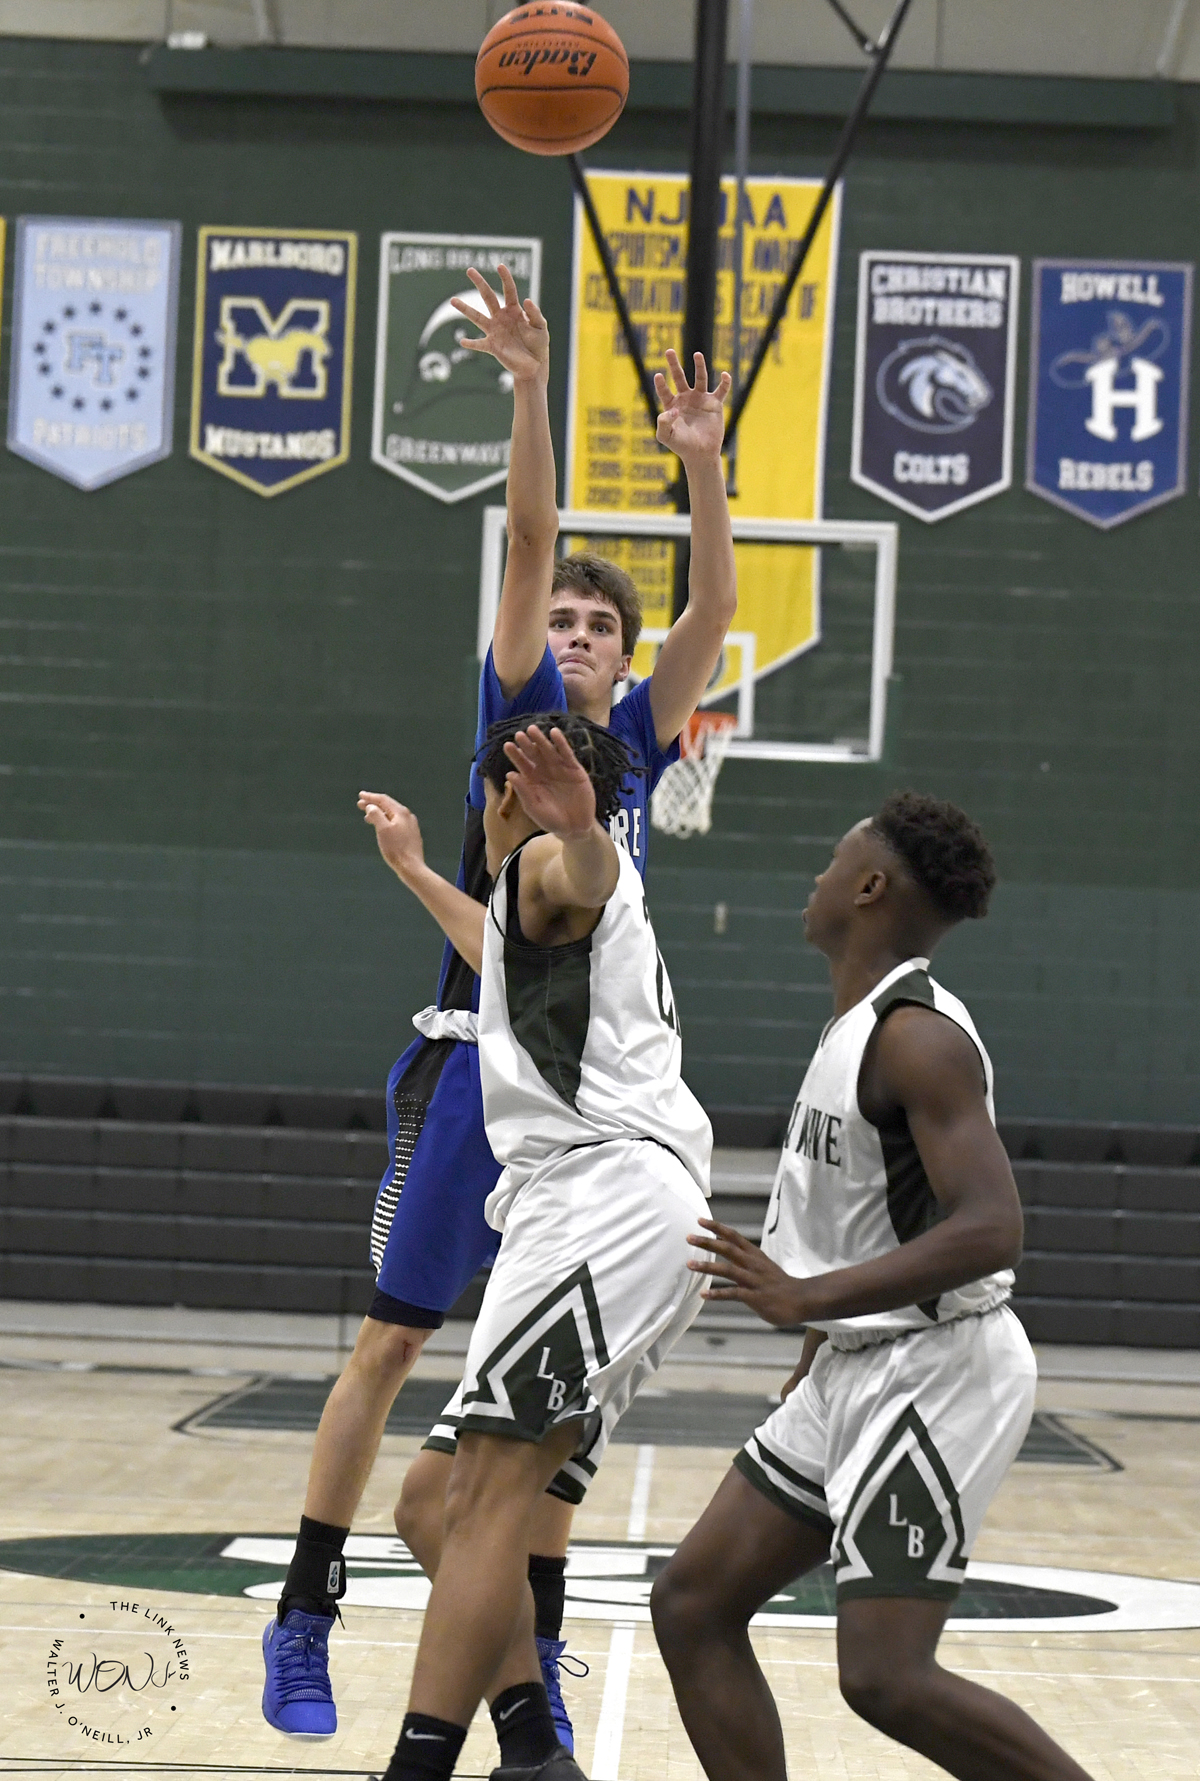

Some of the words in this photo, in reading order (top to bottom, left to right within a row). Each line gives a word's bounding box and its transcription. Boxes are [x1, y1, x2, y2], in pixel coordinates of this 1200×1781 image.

[499, 49, 597, 76] Baden
[210, 239, 346, 276] MARLBORO
[871, 264, 1006, 299] CHRISTIAN
[1061, 272, 1166, 307] HOWELL
[873, 296, 1004, 329] BROTHERS
[1085, 356, 1165, 443] H
[205, 424, 336, 460] MUSTANGS
[893, 451, 970, 485] COLTS
[1058, 457, 1154, 491] REBELS
